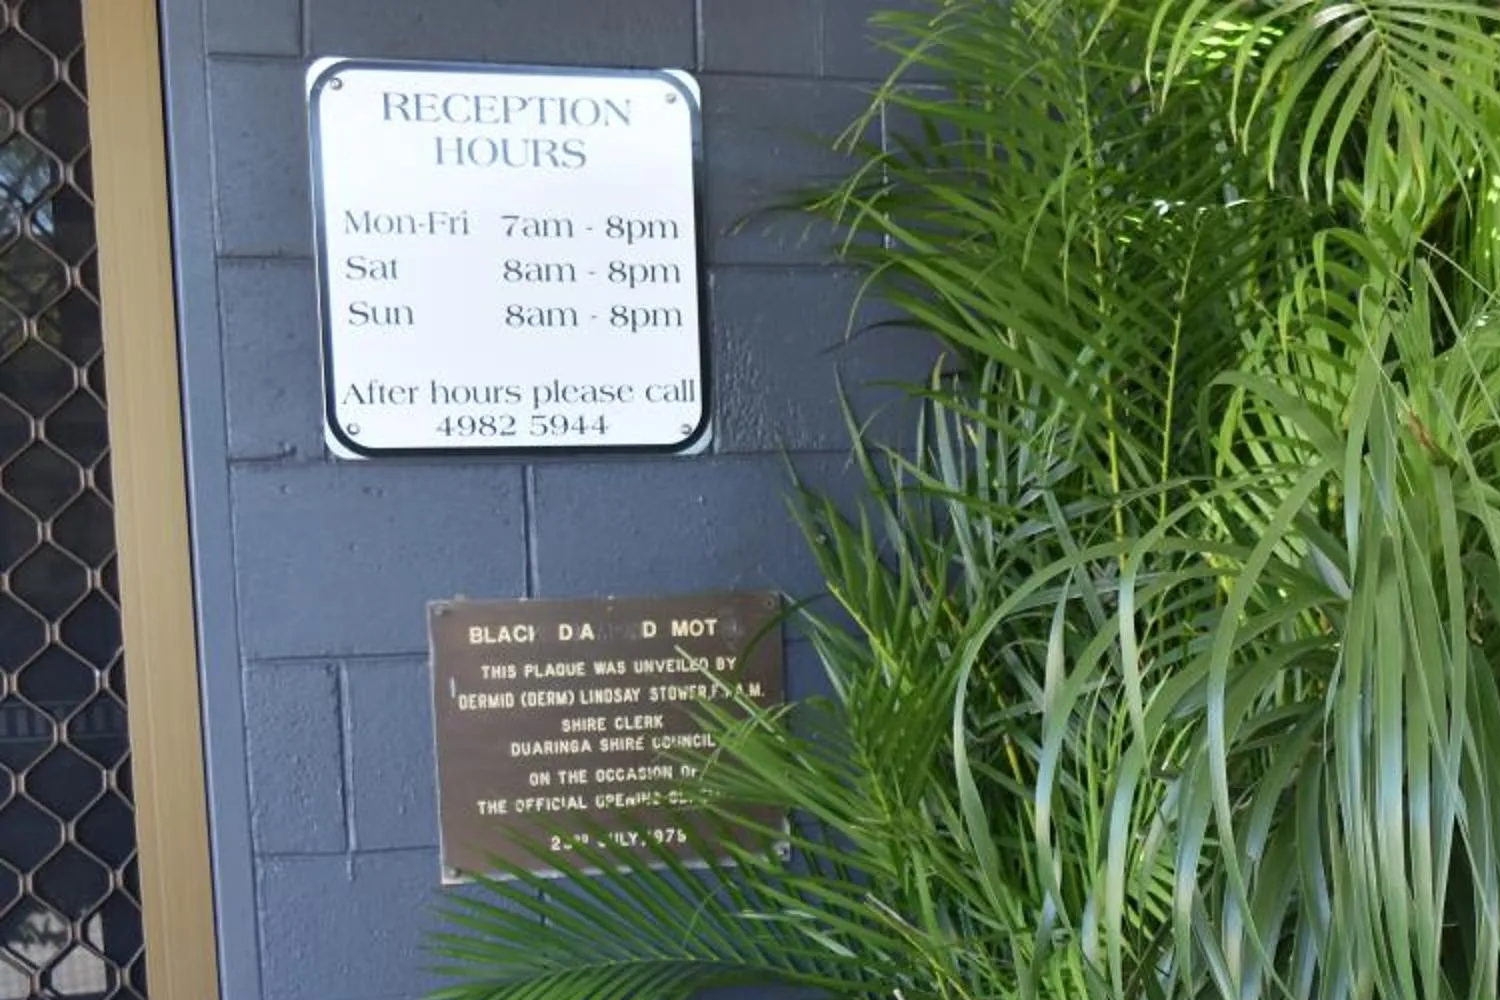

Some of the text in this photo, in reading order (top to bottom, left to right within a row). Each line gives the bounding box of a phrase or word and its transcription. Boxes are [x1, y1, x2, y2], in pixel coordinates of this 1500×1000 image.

[382, 91, 632, 127] RECEPTION
[435, 136, 587, 170] HOURS
[344, 209, 471, 236] Mon-Fri
[500, 215, 574, 239] 7am
[605, 215, 679, 245] 8pm
[346, 255, 399, 281] Sat
[503, 259, 576, 283] 8am
[608, 259, 681, 289] 8pm
[348, 301, 414, 327] Sun
[505, 304, 578, 328] 8am
[609, 304, 683, 333] 8pm
[341, 379, 696, 409] After hours please call
[436, 415, 610, 436] 4982 5944
[481, 664, 516, 680] THIS
[524, 662, 586, 678] PLAQUE
[594, 660, 626, 676] WAS
[716, 655, 737, 671] BY
[458, 692, 515, 711] DERMID
[521, 690, 575, 709] (DERM)
[580, 685, 641, 705] LINDSAY
[561, 715, 663, 733] SHIRE CLERK
[510, 741, 592, 757] DUARINGA
[600, 737, 645, 753] SHIRE
[529, 770, 551, 787] ON
[558, 769, 588, 785] THE
[595, 766, 673, 783] OCCASION
[477, 799, 507, 815] THE
[515, 796, 588, 814] OFFICIAL
